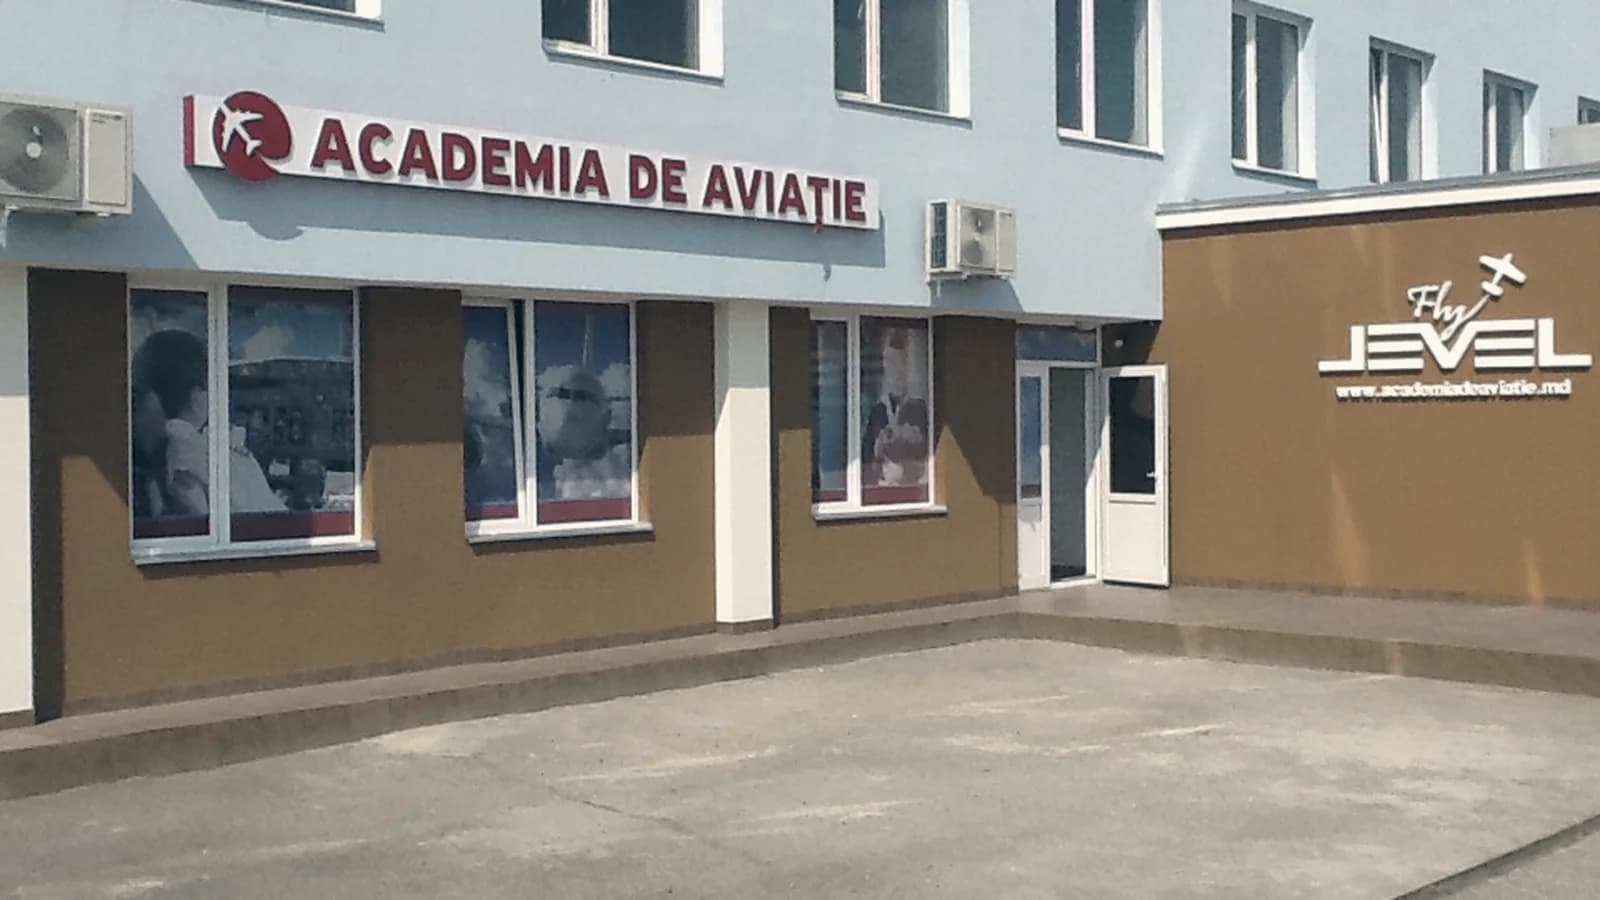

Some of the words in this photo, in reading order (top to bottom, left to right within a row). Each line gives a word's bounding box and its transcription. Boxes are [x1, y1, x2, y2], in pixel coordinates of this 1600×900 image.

[310, 117, 610, 196] ACADEMIA
[629, 154, 687, 204] DE
[1407, 281, 1469, 342] Fly
